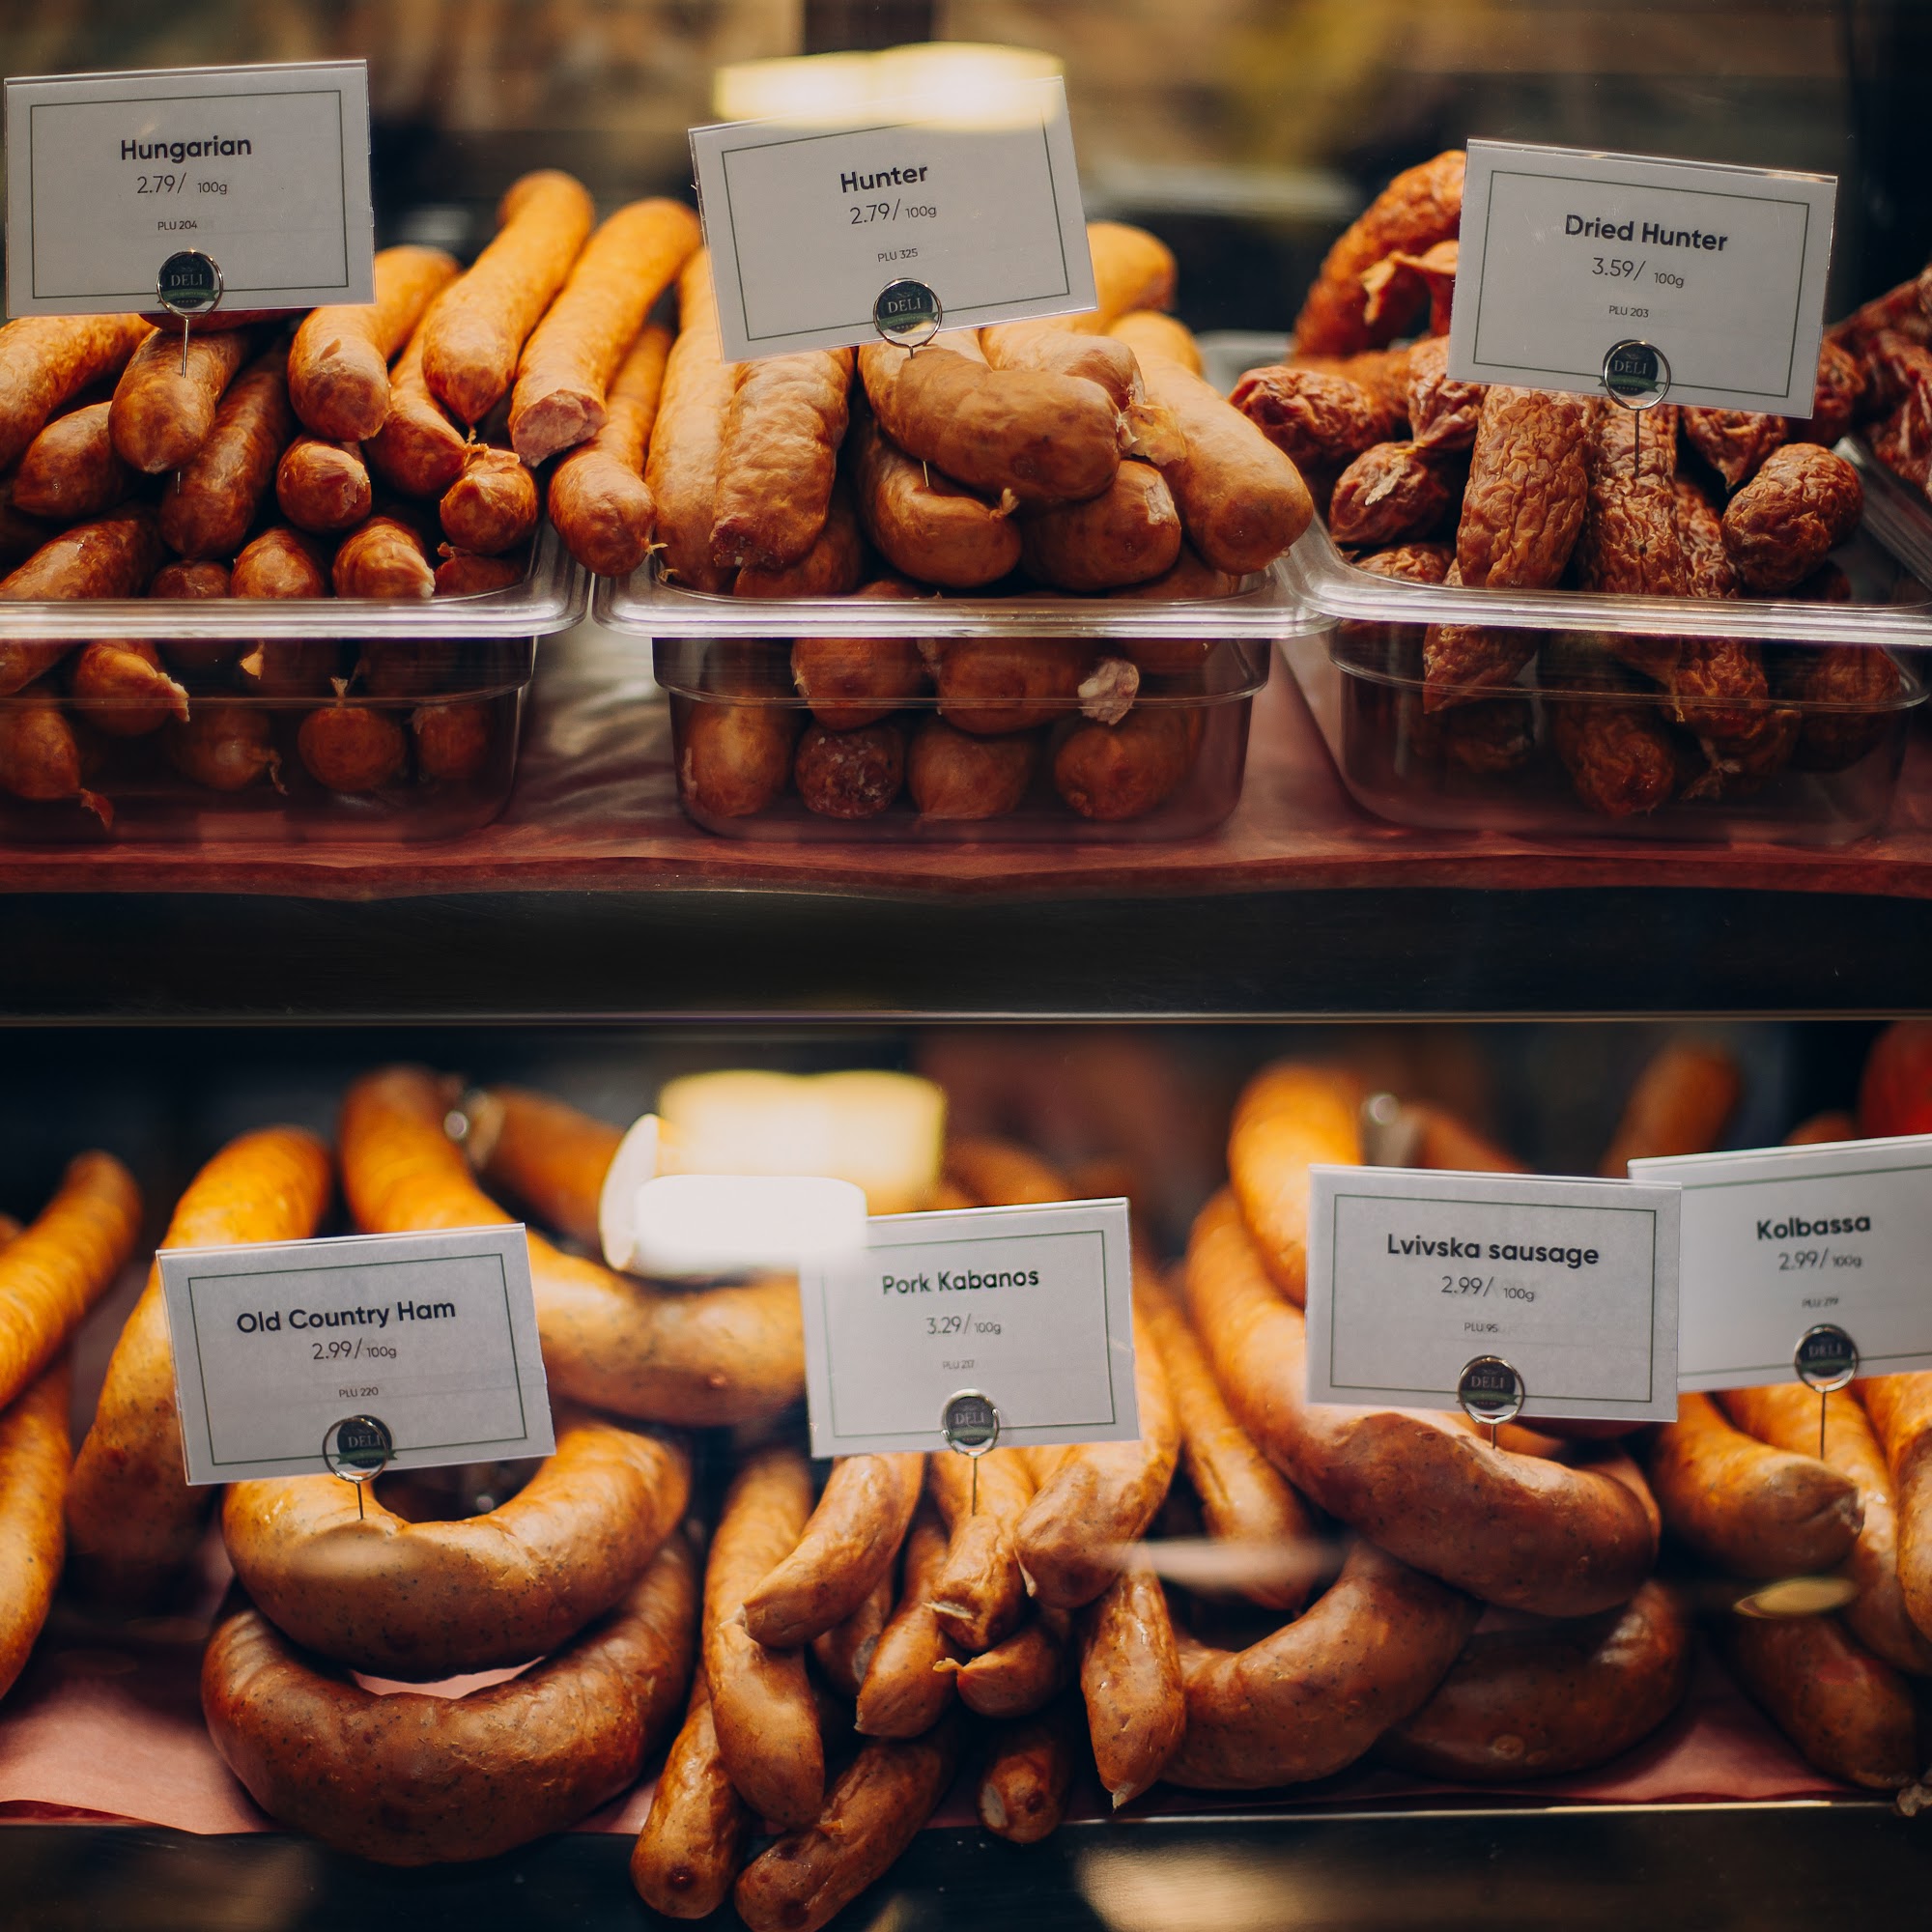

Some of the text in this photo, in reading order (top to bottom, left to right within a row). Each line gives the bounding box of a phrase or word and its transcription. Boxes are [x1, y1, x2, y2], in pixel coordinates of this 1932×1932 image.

[121, 135, 252, 164] Hungarian
[137, 172, 228, 195] 2.79/ 100g
[840, 166, 927, 193] Hunter
[850, 199, 937, 224] 2.79/ 100g
[157, 220, 198, 231] PLU 204
[1565, 214, 1728, 251] Dried Hunter
[877, 247, 919, 263] PLU 325
[170, 273, 203, 287] DELI
[1592, 257, 1685, 289] 3.59/ 100g
[888, 298, 923, 314] DELI
[1608, 305, 1650, 319] PLU 203
[1614, 359, 1648, 375] DELI
[1756, 1215, 1872, 1240] Kolbassa
[1387, 1234, 1600, 1269] Lvivska sausage
[1778, 1247, 1862, 1271] 2.99/ 100g
[882, 1269, 1039, 1295] Pork Kabanos
[1440, 1275, 1535, 1303] 2.99/ 100g
[237, 1299, 457, 1334] Old Country Ham
[926, 1313, 1002, 1335] 3.29/ 100g
[1463, 1321, 1498, 1333] PLU 95
[311, 1337, 397, 1360] 2.99/ 100g
[942, 1360, 960, 1370] PLU
[339, 1386, 379, 1398] PLU 220
[1470, 1375, 1505, 1389] DELI
[954, 1411, 984, 1426] DELI
